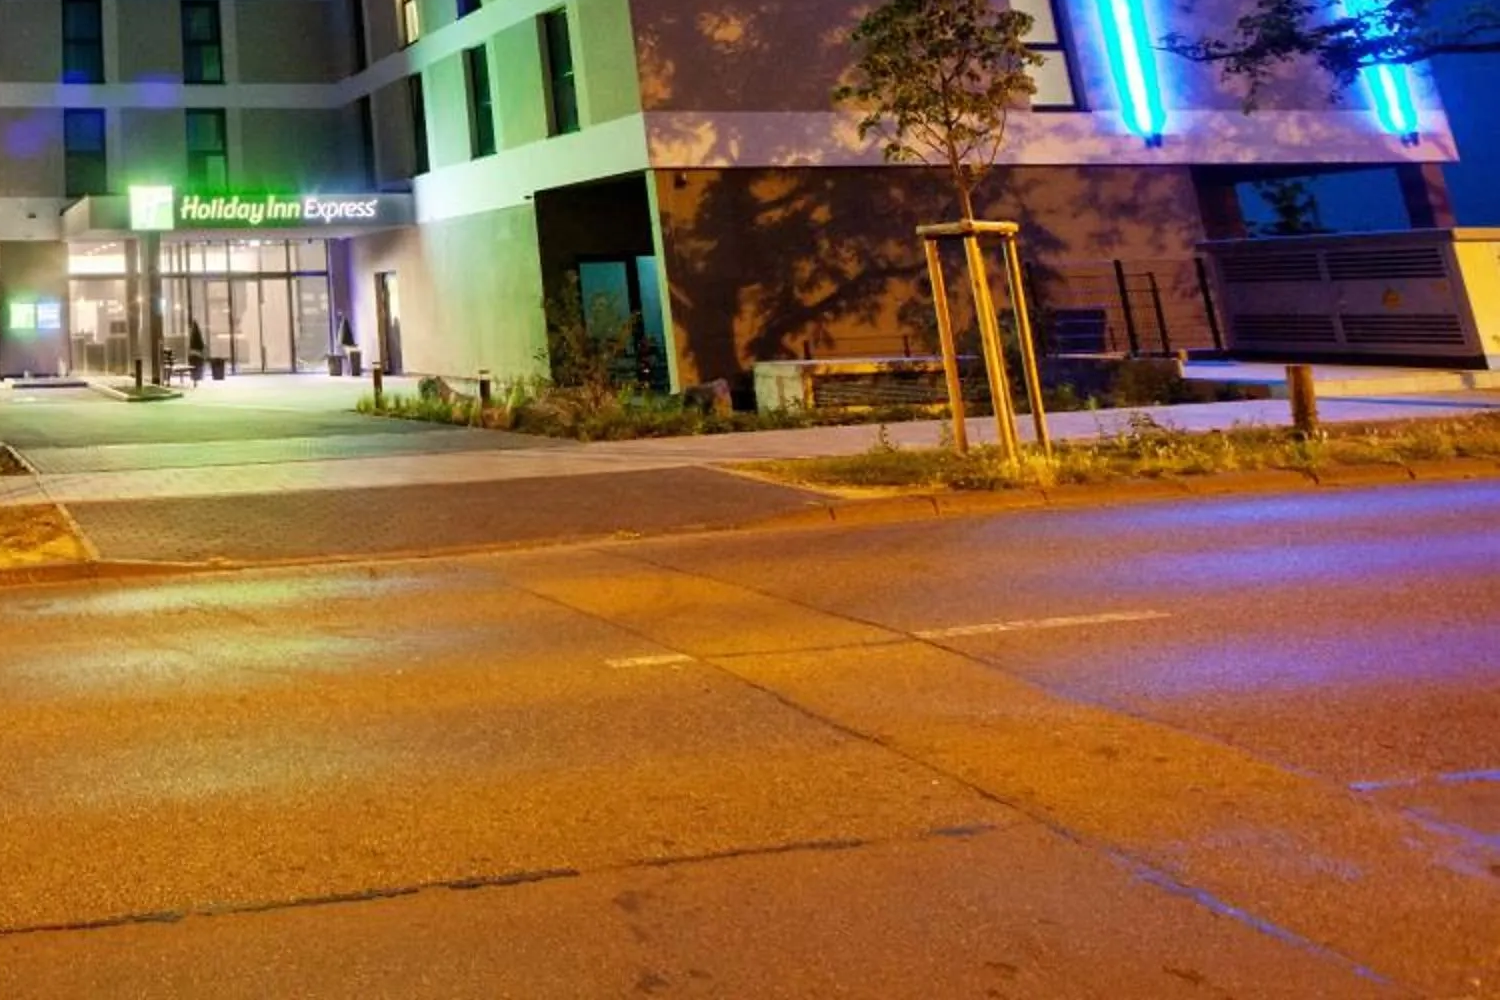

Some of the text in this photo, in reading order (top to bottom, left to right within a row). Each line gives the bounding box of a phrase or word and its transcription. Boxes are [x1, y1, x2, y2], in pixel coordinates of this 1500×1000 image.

[181, 195, 264, 225] Holiday
[266, 195, 300, 219] Inn
[303, 198, 376, 224] Express
